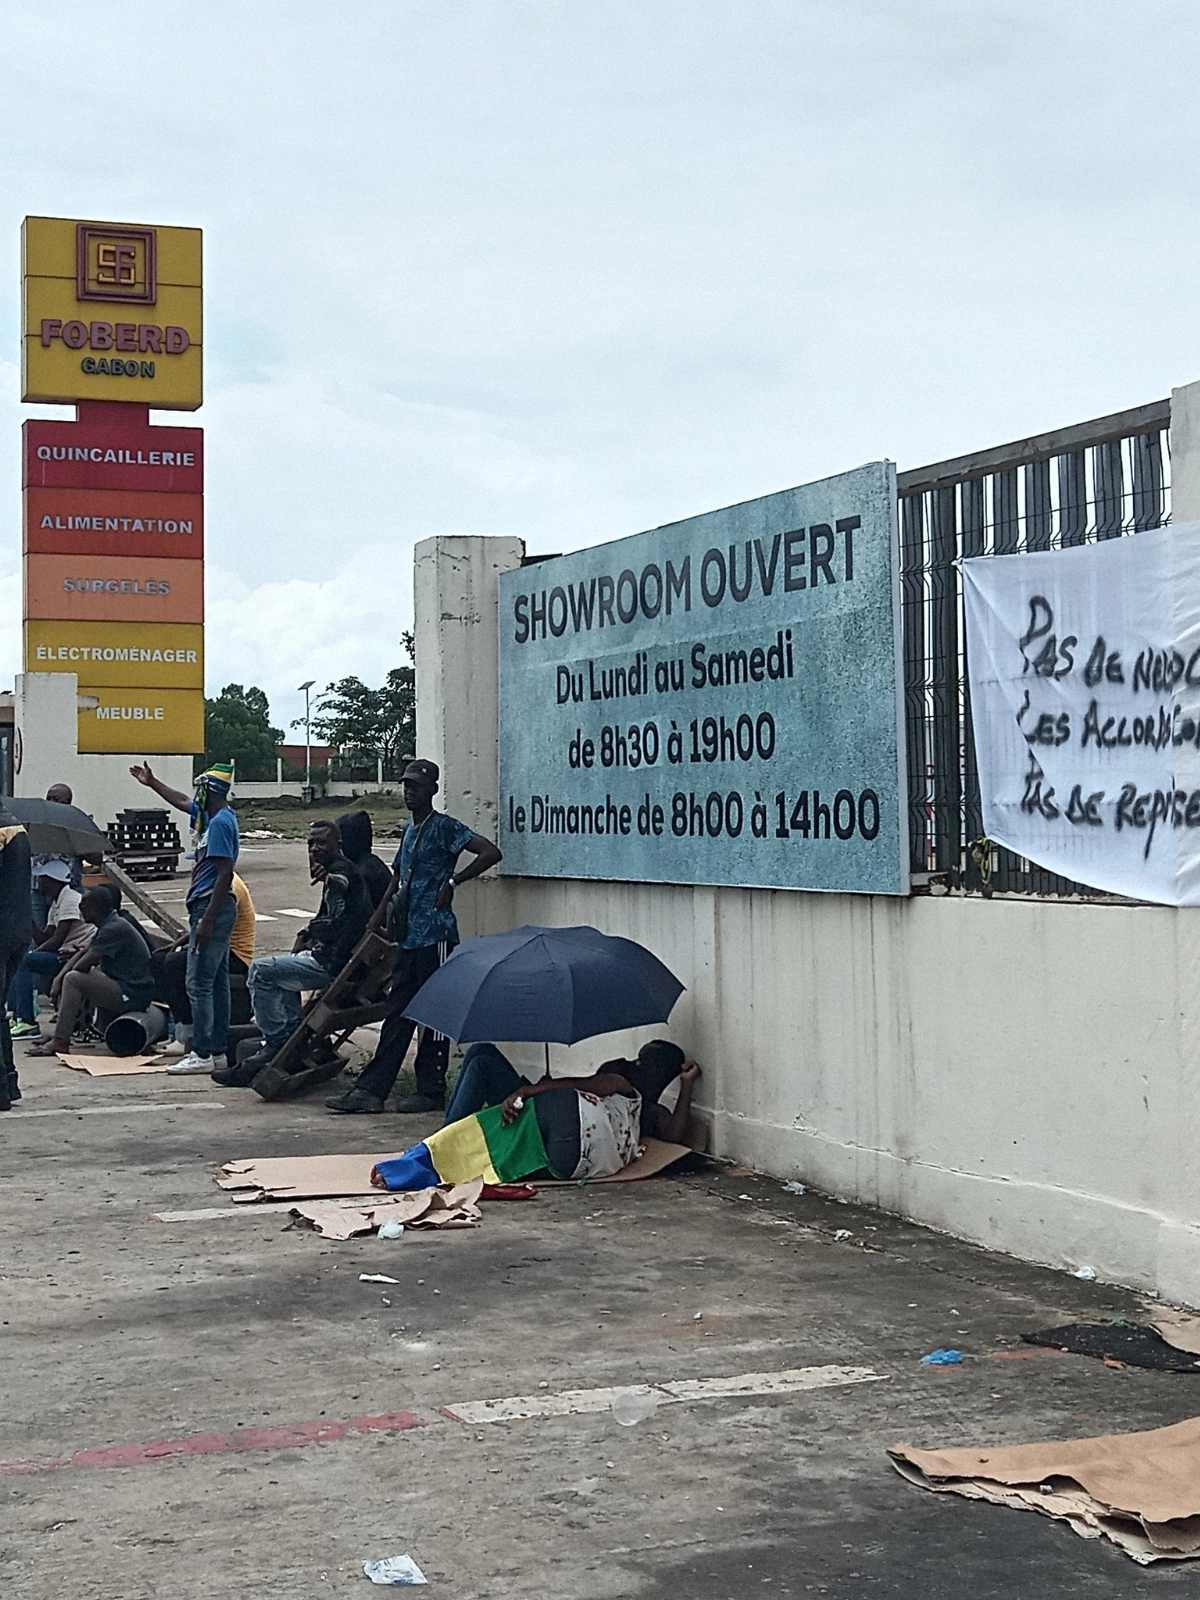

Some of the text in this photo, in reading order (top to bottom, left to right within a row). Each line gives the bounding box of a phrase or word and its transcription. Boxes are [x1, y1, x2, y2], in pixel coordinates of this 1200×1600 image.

[41, 319, 190, 354] FOBERD
[81, 357, 155, 378] GABON
[36, 445, 196, 467] QUINCAILLERIE
[40, 515, 192, 534] ALIMENTATION
[514, 515, 861, 643] SHOWROOM OUVERT
[36, 643, 197, 663] ÉLECTROMÉNAGER
[556, 629, 793, 704] Du Lundi au Samedi
[96, 706, 165, 720] MEUBLE
[569, 712, 775, 768] de 8h30 à 19h00
[509, 788, 880, 841] le Dimanche de 8h00 à 14h00
